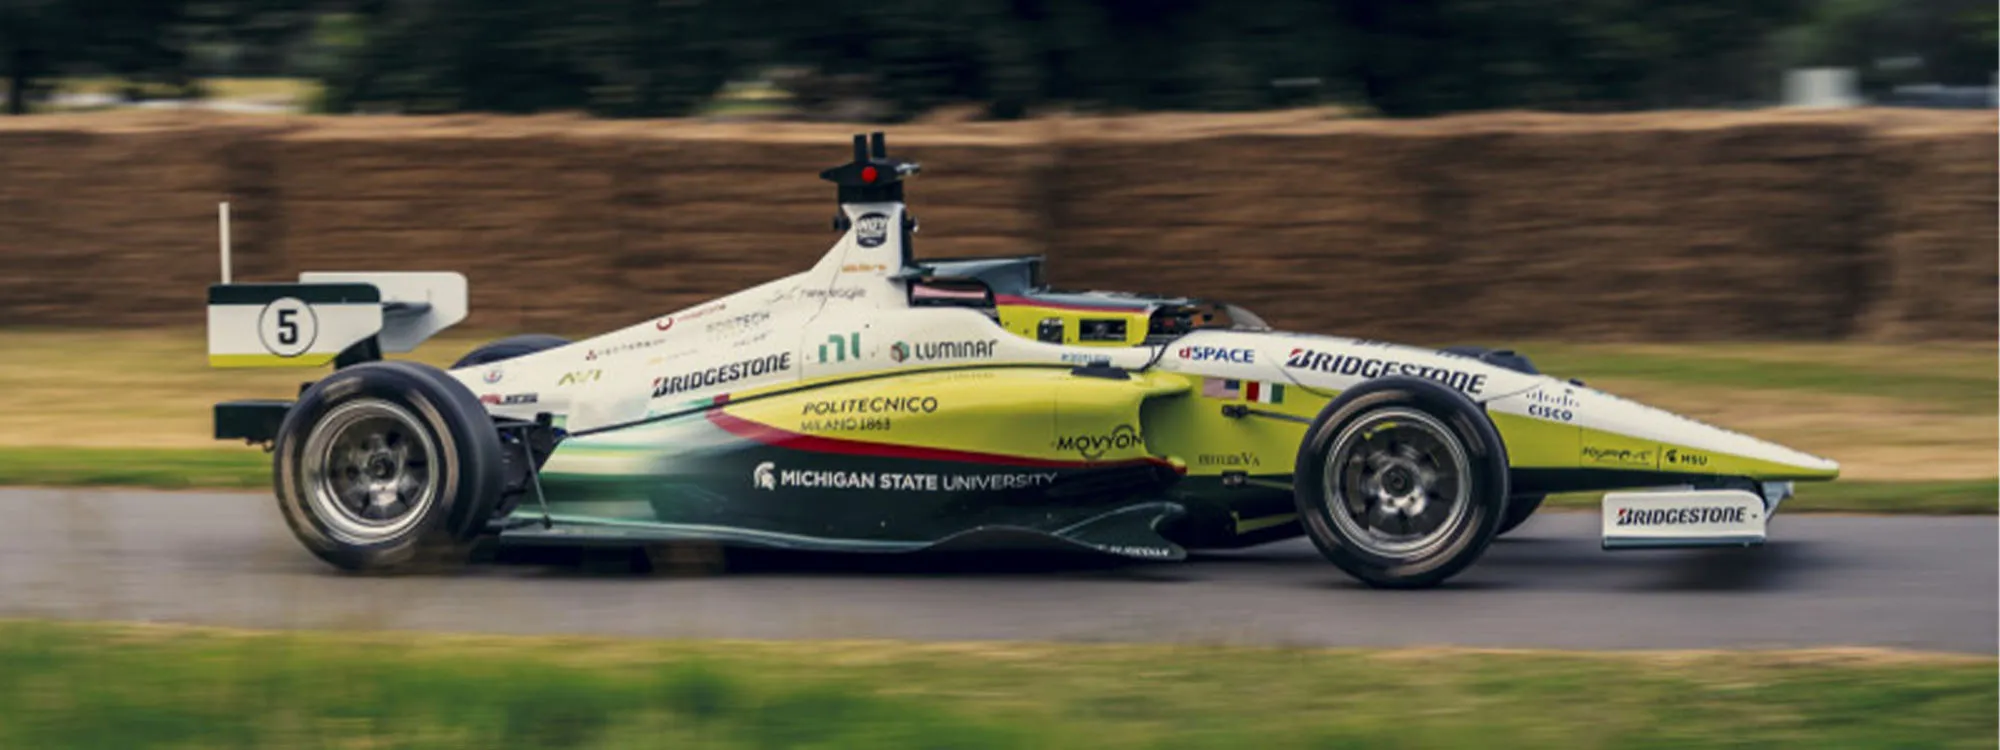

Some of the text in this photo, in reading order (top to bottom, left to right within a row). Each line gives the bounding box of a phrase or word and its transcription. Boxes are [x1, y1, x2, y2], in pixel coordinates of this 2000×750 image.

[278, 309, 298, 345] 5
[1178, 346, 1255, 363] dSPACE
[651, 352, 791, 399] BRIDGESTONE
[802, 396, 938, 415] POLITECNICO
[1528, 404, 1574, 421] CISCO
[800, 417, 891, 431] MILANO 1863
[1056, 430, 1145, 453] MOVYON
[1681, 454, 1708, 465] MSU
[781, 470, 1058, 491] MICHIGAN STATE UNIVERSITY
[1616, 507, 1747, 526] BRIDGESTONE
